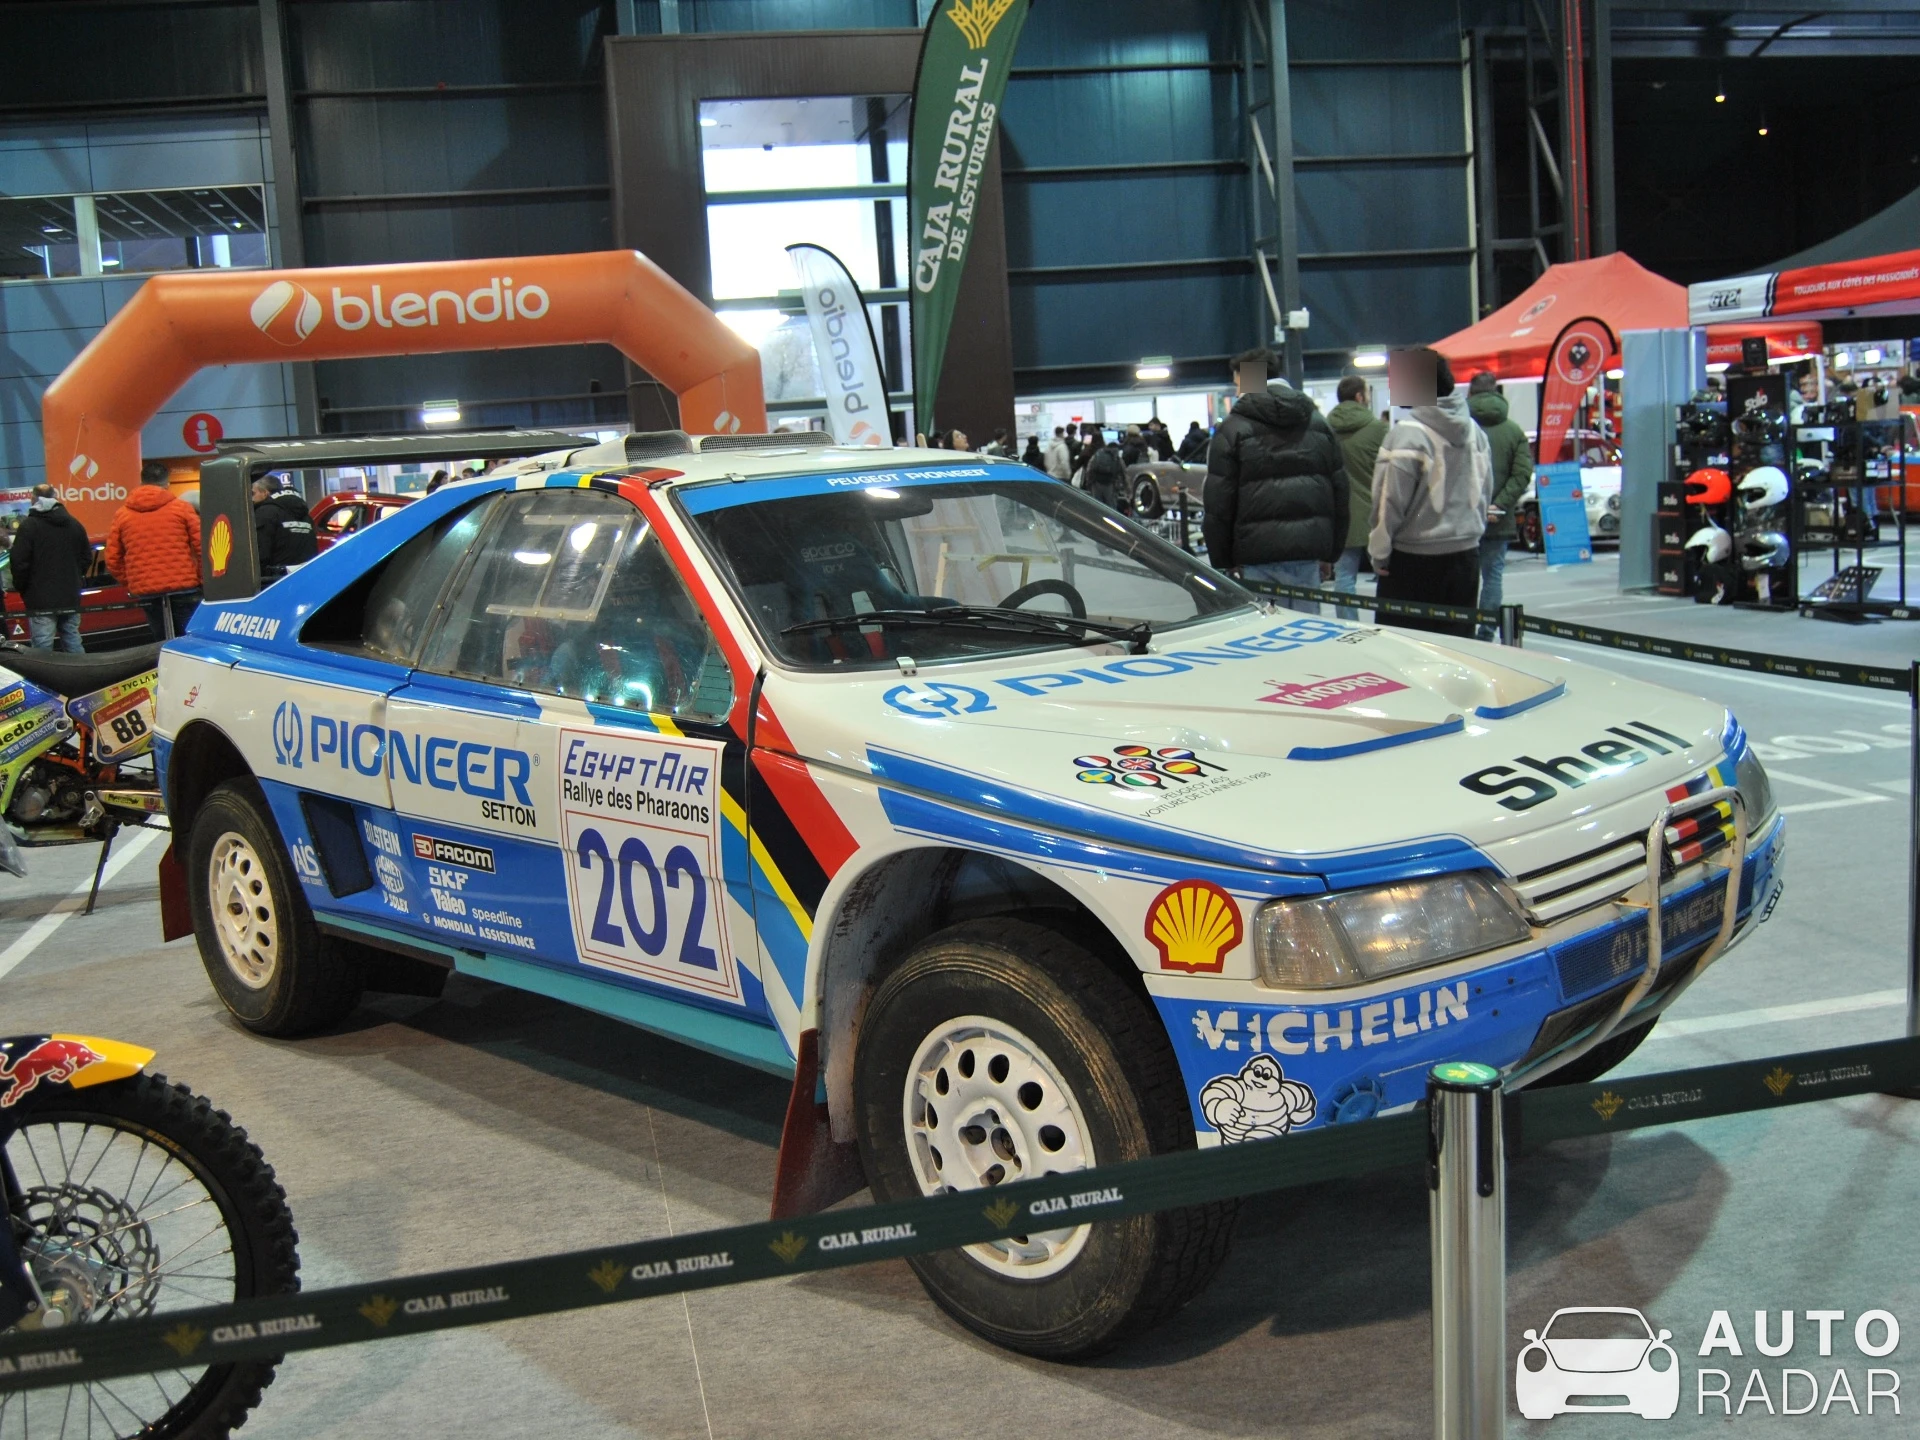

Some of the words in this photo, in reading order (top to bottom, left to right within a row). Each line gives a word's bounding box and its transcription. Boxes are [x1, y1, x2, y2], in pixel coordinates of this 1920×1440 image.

[915, 201, 953, 293] CAJA
[934, 58, 989, 193] RURAL
[956, 102, 996, 225] ASTURIAS
[947, 226, 967, 261] DE
[332, 277, 550, 331] blendio
[826, 473, 900, 487] PEUGEOT
[904, 468, 990, 480] PIONEER
[214, 612, 280, 641] MICHELIN
[992, 618, 1360, 697] PIONEER
[122, 680, 138, 691] TYC
[1276, 675, 1388, 706] KHODRO
[111, 709, 147, 743] 88
[311, 715, 534, 806] PIONEER
[1459, 721, 1693, 811] Shell
[563, 779, 603, 808] Rallye
[607, 787, 633, 810] des
[637, 790, 709, 824] Pharaons
[1139, 798, 1189, 818] VOITURE
[1187, 792, 1204, 802] DE
[1160, 782, 1210, 800] PEUGEOT
[482, 800, 536, 827] SETTON
[363, 819, 402, 857] BILSTEIN
[435, 842, 493, 869] FACOM
[428, 866, 469, 891] SKF
[390, 898, 409, 914] SOLEX
[431, 888, 467, 916] Valeo
[577, 828, 718, 972] 202
[472, 907, 523, 929] speedline
[434, 916, 476, 936] MONDIAL
[479, 927, 536, 950] ASSISTANCE
[1192, 981, 1469, 1055] MICHELIN
[1030, 1195, 1068, 1216] CAJA
[1070, 1188, 1123, 1211] RURAL
[819, 1230, 859, 1251] CAJA
[861, 1223, 917, 1246] RURAL
[631, 1259, 673, 1281] CAJA
[675, 1252, 734, 1275] RURAL
[404, 1296, 447, 1314] CAJA
[449, 1287, 510, 1310] RURAL
[212, 1325, 256, 1343] CAJA
[260, 1314, 322, 1339] RURAL
[19, 1348, 83, 1371] RURAL
